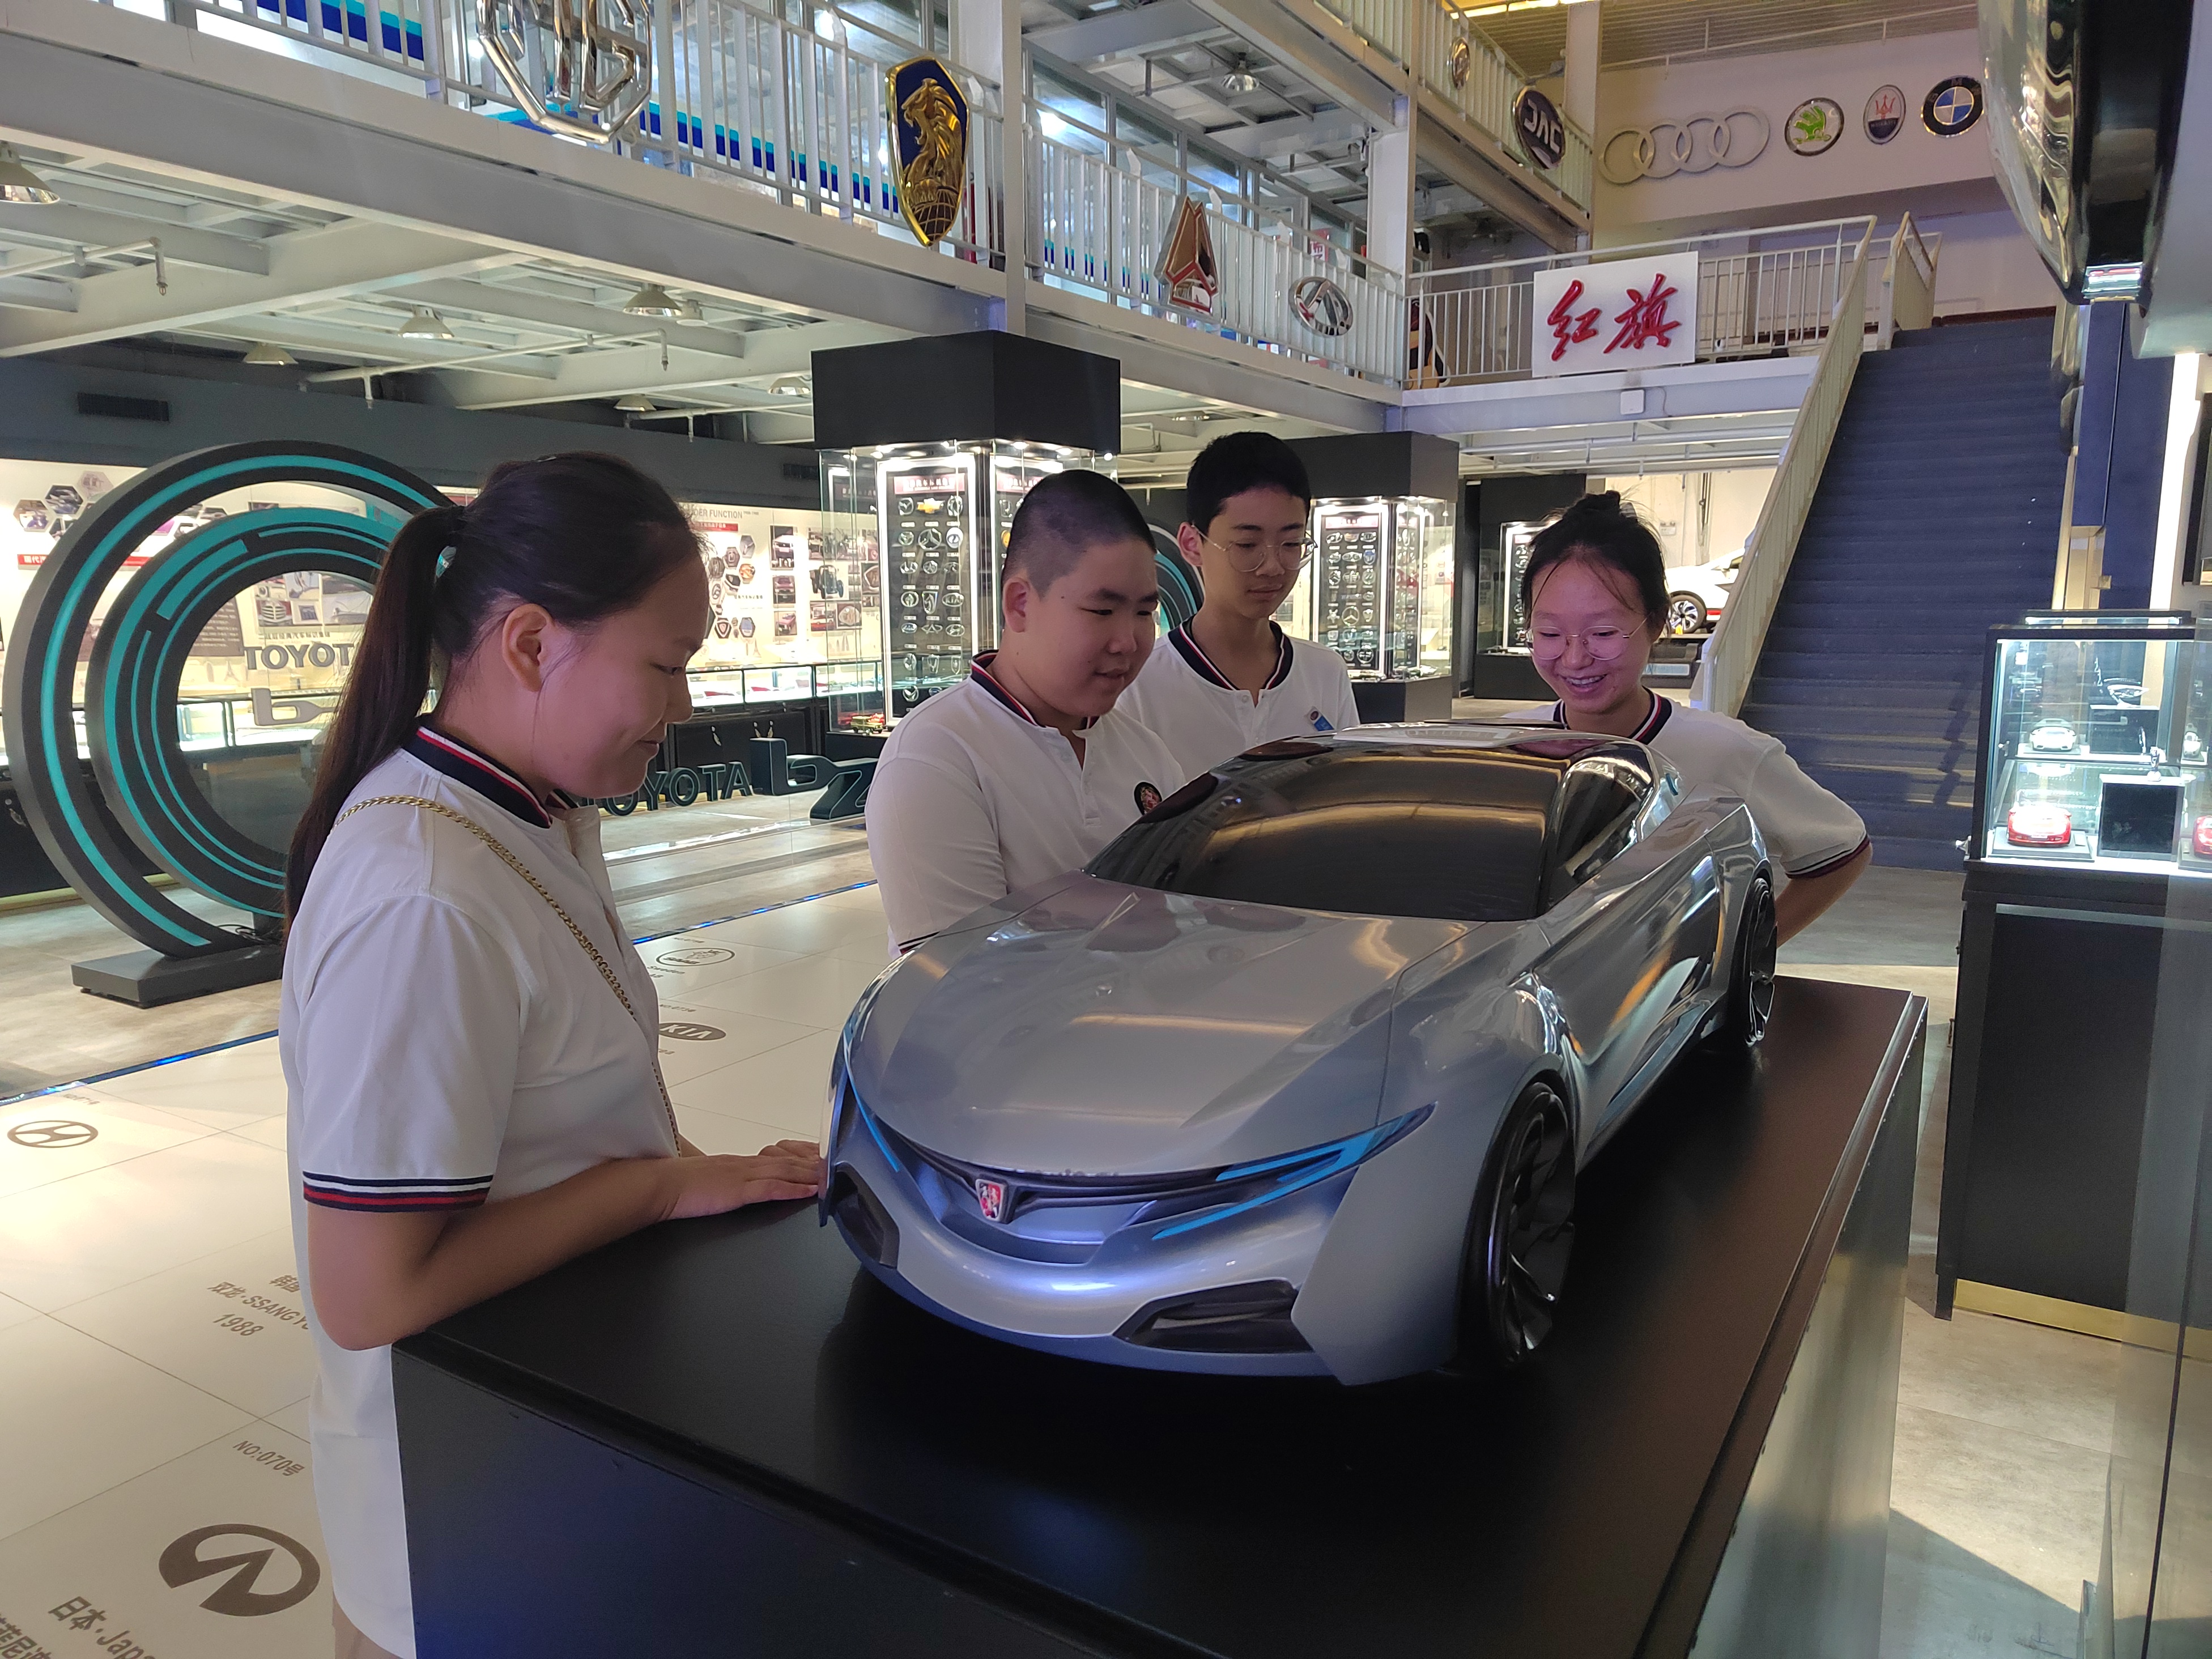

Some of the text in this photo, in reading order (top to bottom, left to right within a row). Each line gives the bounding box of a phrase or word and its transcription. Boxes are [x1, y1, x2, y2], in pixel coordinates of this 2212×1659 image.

[1524, 99, 1562, 154] JAC
[1547, 273, 1682, 361] 红旗
[709, 509, 743, 518] FUNCTION
[244, 643, 354, 670] TOYOT
[581, 762, 754, 816] OYOTA
[647, 965, 686, 975] Sweden
[659, 1026, 713, 1039] KIA
[212, 1313, 265, 1336] 1988
[47, 1596, 156, 1659] 日本·Jap
